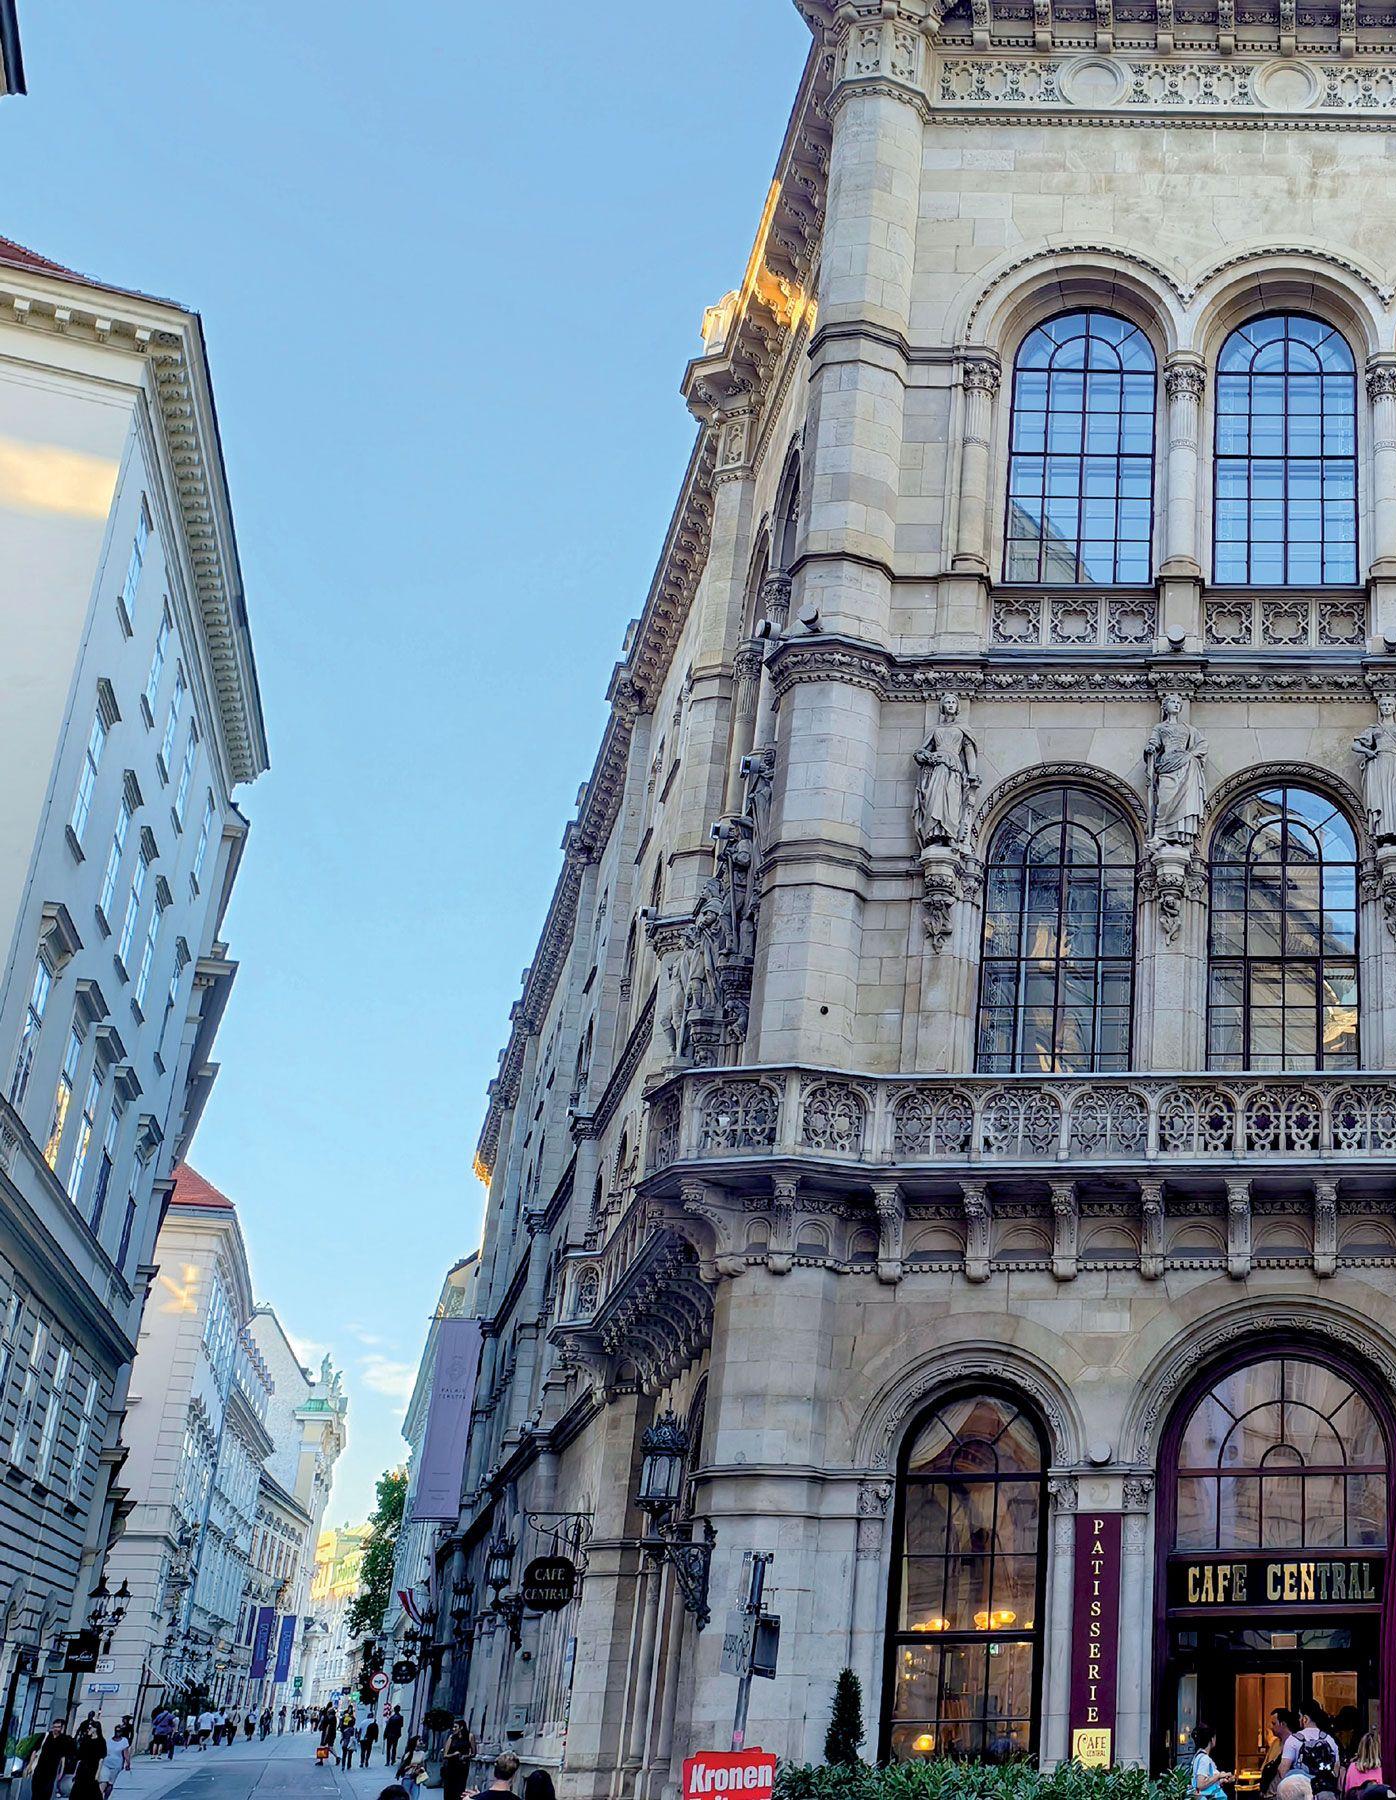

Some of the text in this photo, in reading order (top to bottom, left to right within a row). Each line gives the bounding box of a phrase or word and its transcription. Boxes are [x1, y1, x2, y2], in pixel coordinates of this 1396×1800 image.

[535, 1568, 565, 1581] CAFE
[1188, 1563, 1375, 1603] CAFE CENTRAL
[524, 1588, 570, 1600] CENTRAL
[1087, 1519, 1104, 1722] PATISSERIE
[1077, 1733, 1107, 1757] CAFE
[689, 1763, 773, 1793] Kronen
